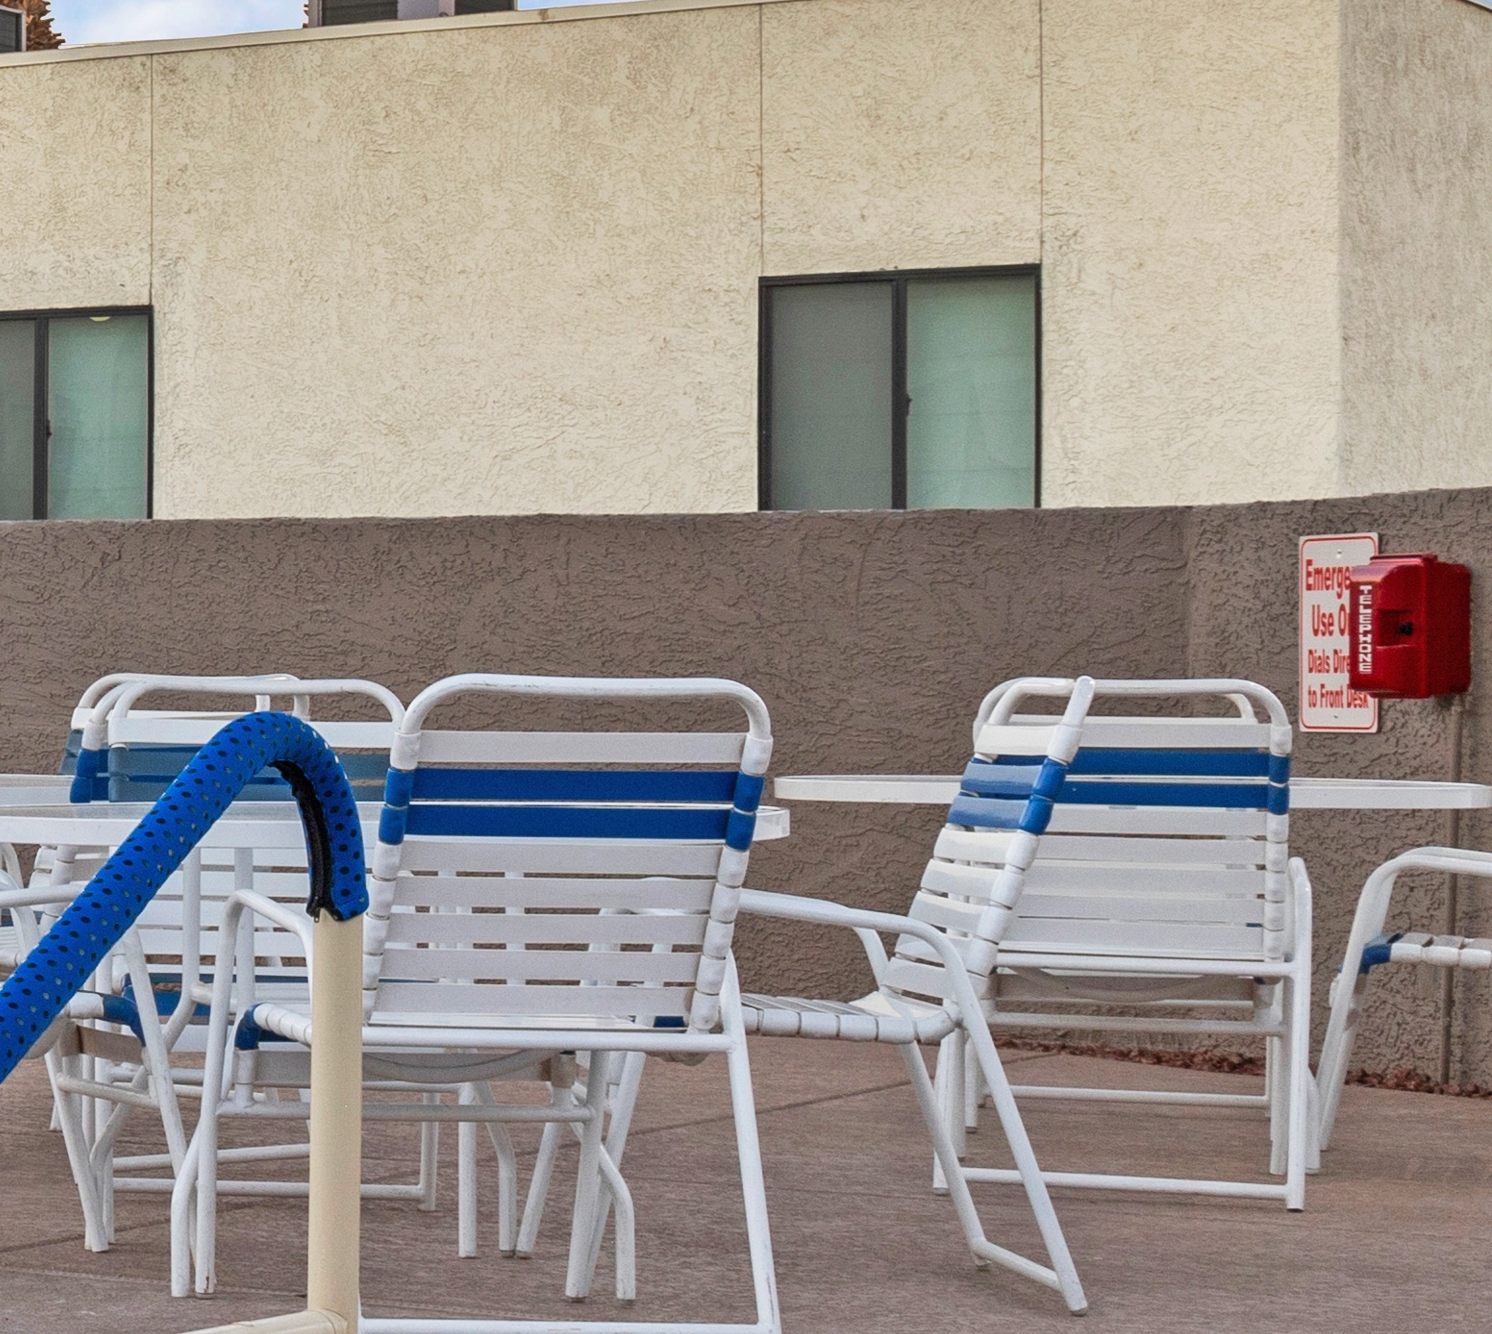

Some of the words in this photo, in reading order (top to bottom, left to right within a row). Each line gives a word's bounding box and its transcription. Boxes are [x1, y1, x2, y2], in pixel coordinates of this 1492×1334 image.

[1306, 559, 1351, 599] Emerge
[1312, 603, 1335, 637] Use
[1359, 584, 1372, 675] TELEPHONE
[1308, 649, 1331, 674] Dials
[1333, 649, 1351, 674] Dire
[1308, 685, 1318, 708] to
[1320, 683, 1344, 708] Front
